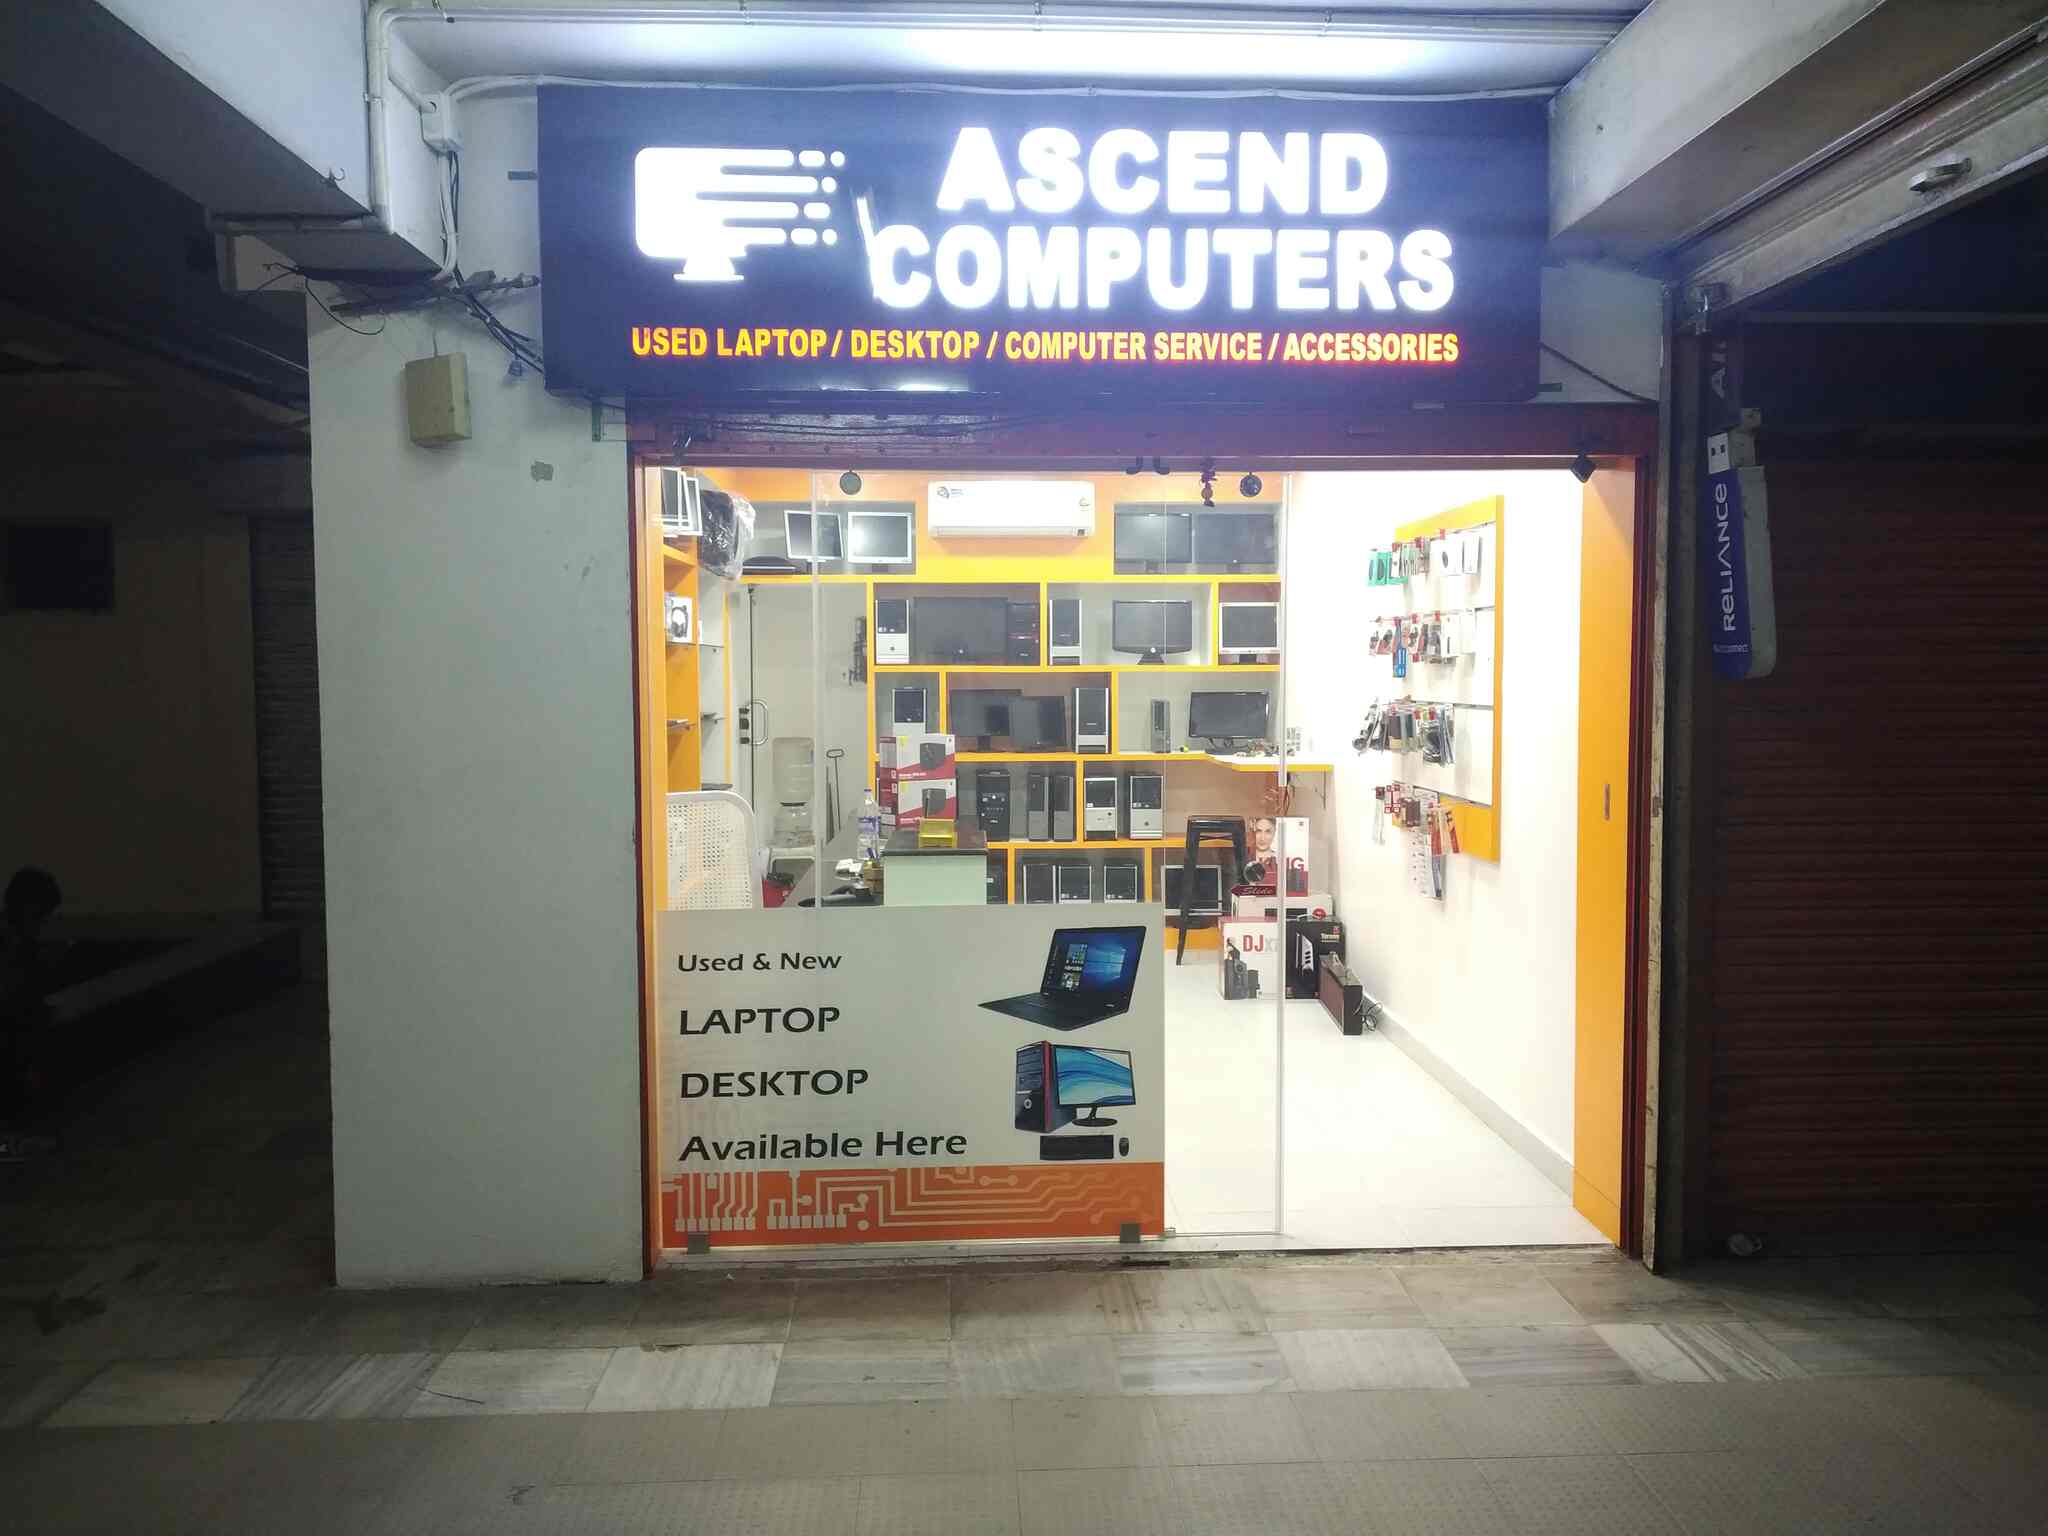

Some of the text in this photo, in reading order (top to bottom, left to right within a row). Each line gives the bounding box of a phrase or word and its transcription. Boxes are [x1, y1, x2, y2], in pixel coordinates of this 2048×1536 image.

[936, 126, 1389, 215] ASCEND
[872, 223, 1456, 312] COMPUTERS
[631, 327, 708, 356] USED
[716, 328, 827, 357] LAPTOP
[850, 329, 980, 359] DESKTOP
[1004, 331, 1147, 361] COMPUTER
[1153, 332, 1263, 362] SERVICE
[1283, 333, 1459, 363] ACCESSORIES
[678, 952, 842, 972] Used & New
[679, 1006, 840, 1036] LAPTOP
[680, 1069, 869, 1099] DESKTOP
[678, 1130, 967, 1162] Available Here
